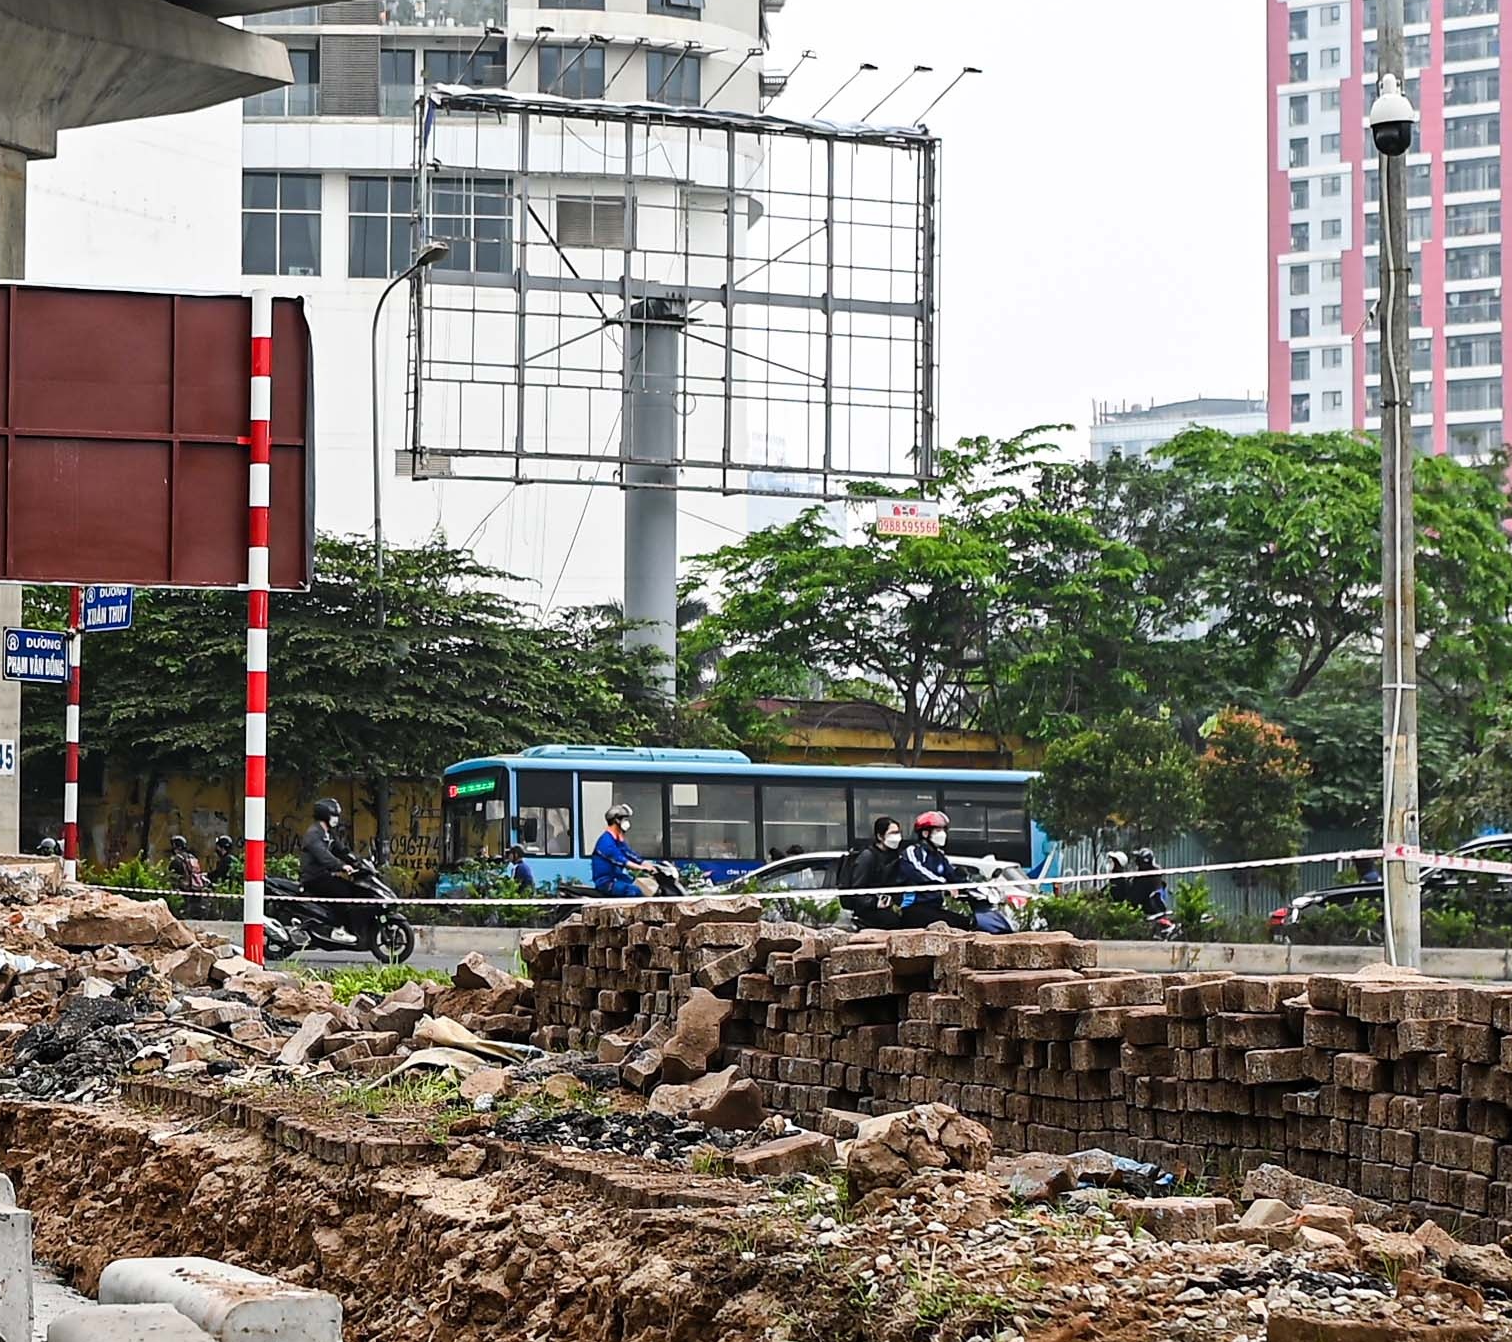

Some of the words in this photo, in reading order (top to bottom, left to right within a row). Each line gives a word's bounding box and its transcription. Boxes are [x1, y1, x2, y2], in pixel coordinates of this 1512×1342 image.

[87, 603, 107, 626] XUÂN
[6, 655, 28, 677] PHẠM
[29, 654, 44, 676] VĂN
